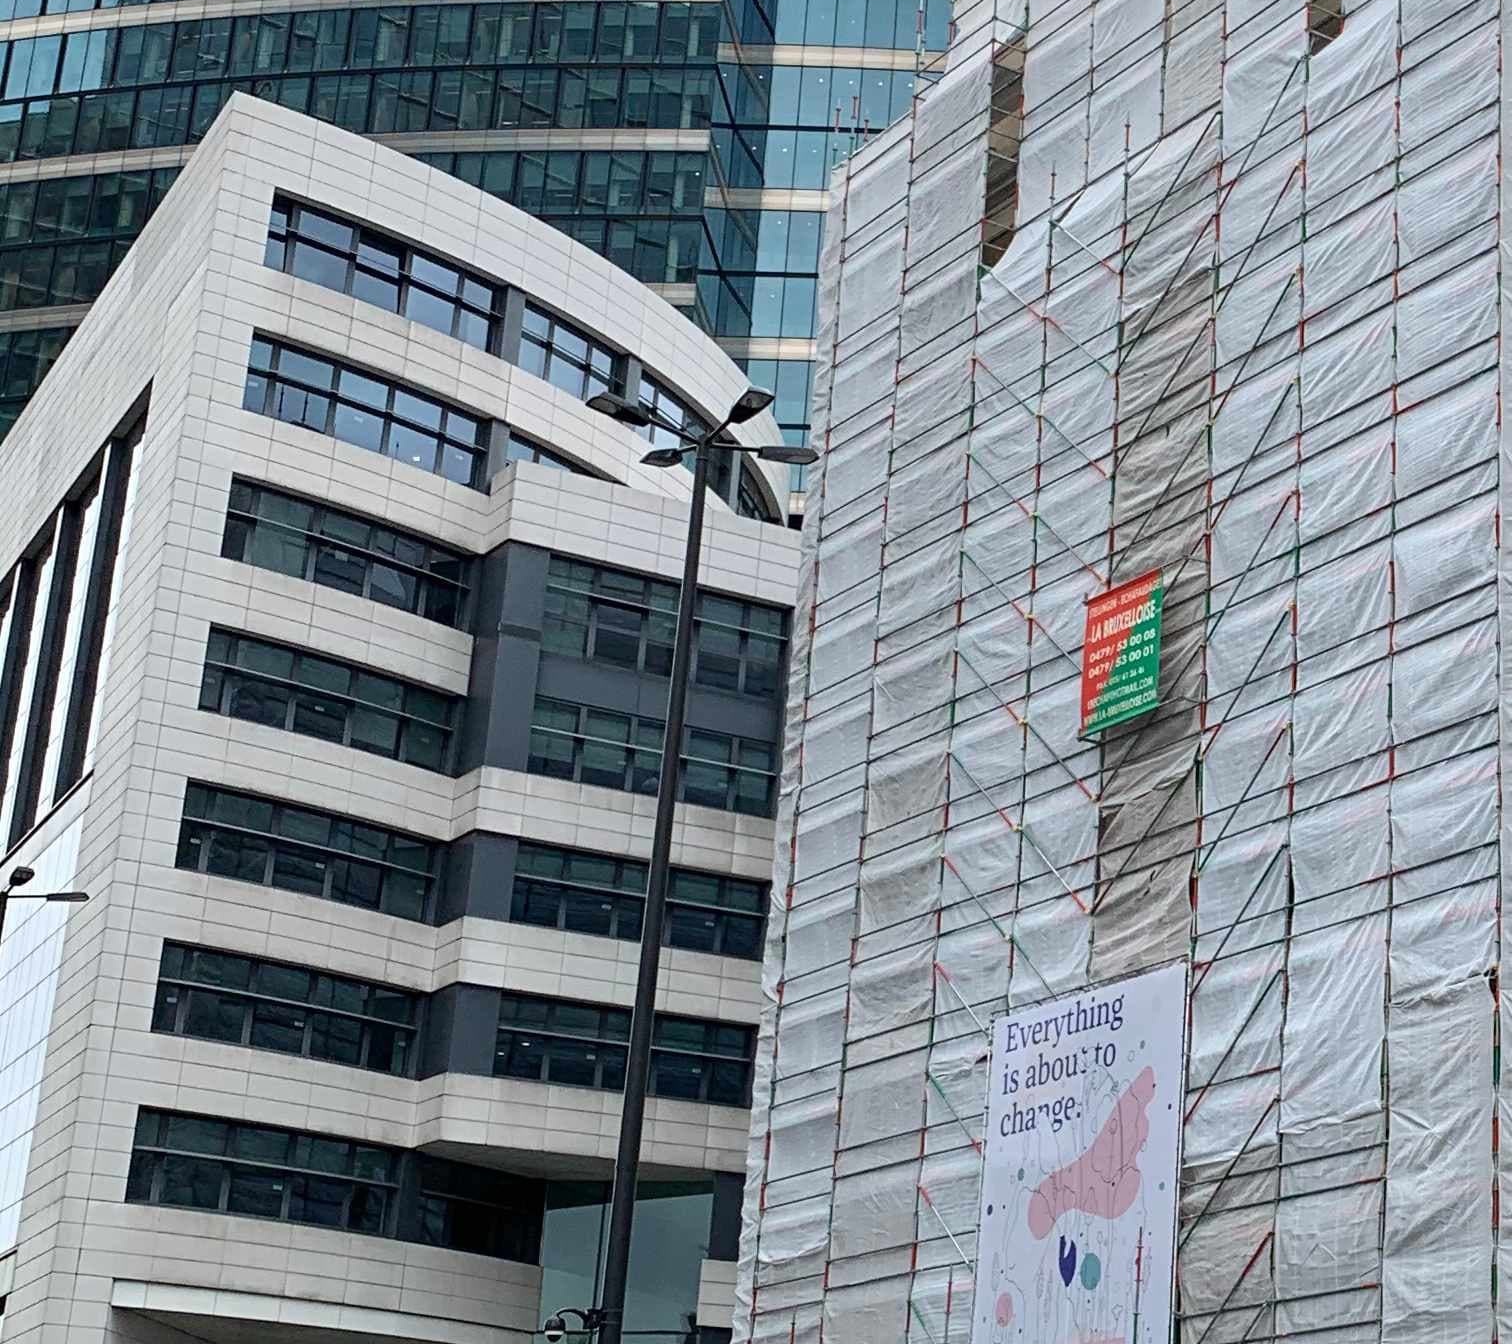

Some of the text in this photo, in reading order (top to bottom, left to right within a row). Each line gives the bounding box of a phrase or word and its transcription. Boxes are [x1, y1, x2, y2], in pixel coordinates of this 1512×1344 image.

[1091, 622, 1102, 643] LA
[1129, 633, 1142, 646] 00
[1128, 649, 1142, 662] 00
[1143, 645, 1154, 657] 01
[1005, 994, 1125, 1054] Everything
[1002, 1042, 1116, 1096] is about to
[1000, 1096, 1081, 1137] change.
